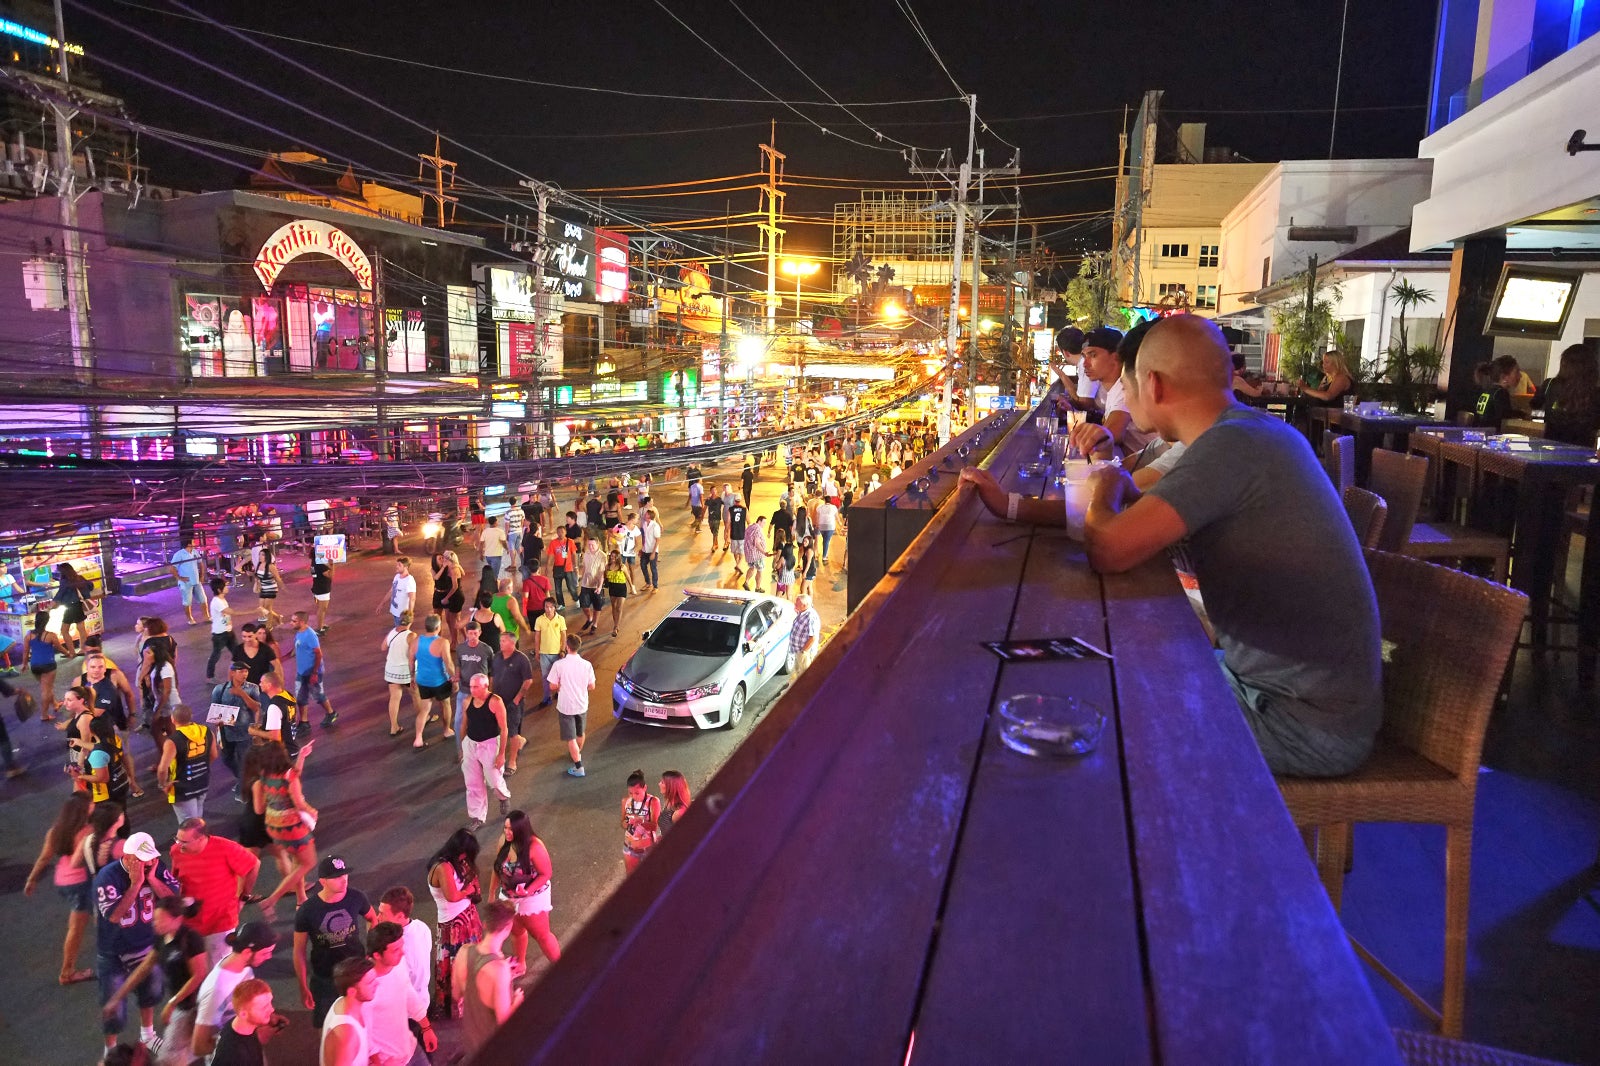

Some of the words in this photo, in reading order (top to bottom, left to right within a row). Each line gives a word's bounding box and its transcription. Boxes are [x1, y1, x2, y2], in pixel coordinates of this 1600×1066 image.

[256, 224, 321, 286] Moulin
[734, 513, 741, 522] 6
[325, 549, 338, 560] 80
[680, 611, 729, 621] POLICE
[97, 885, 117, 901] 33
